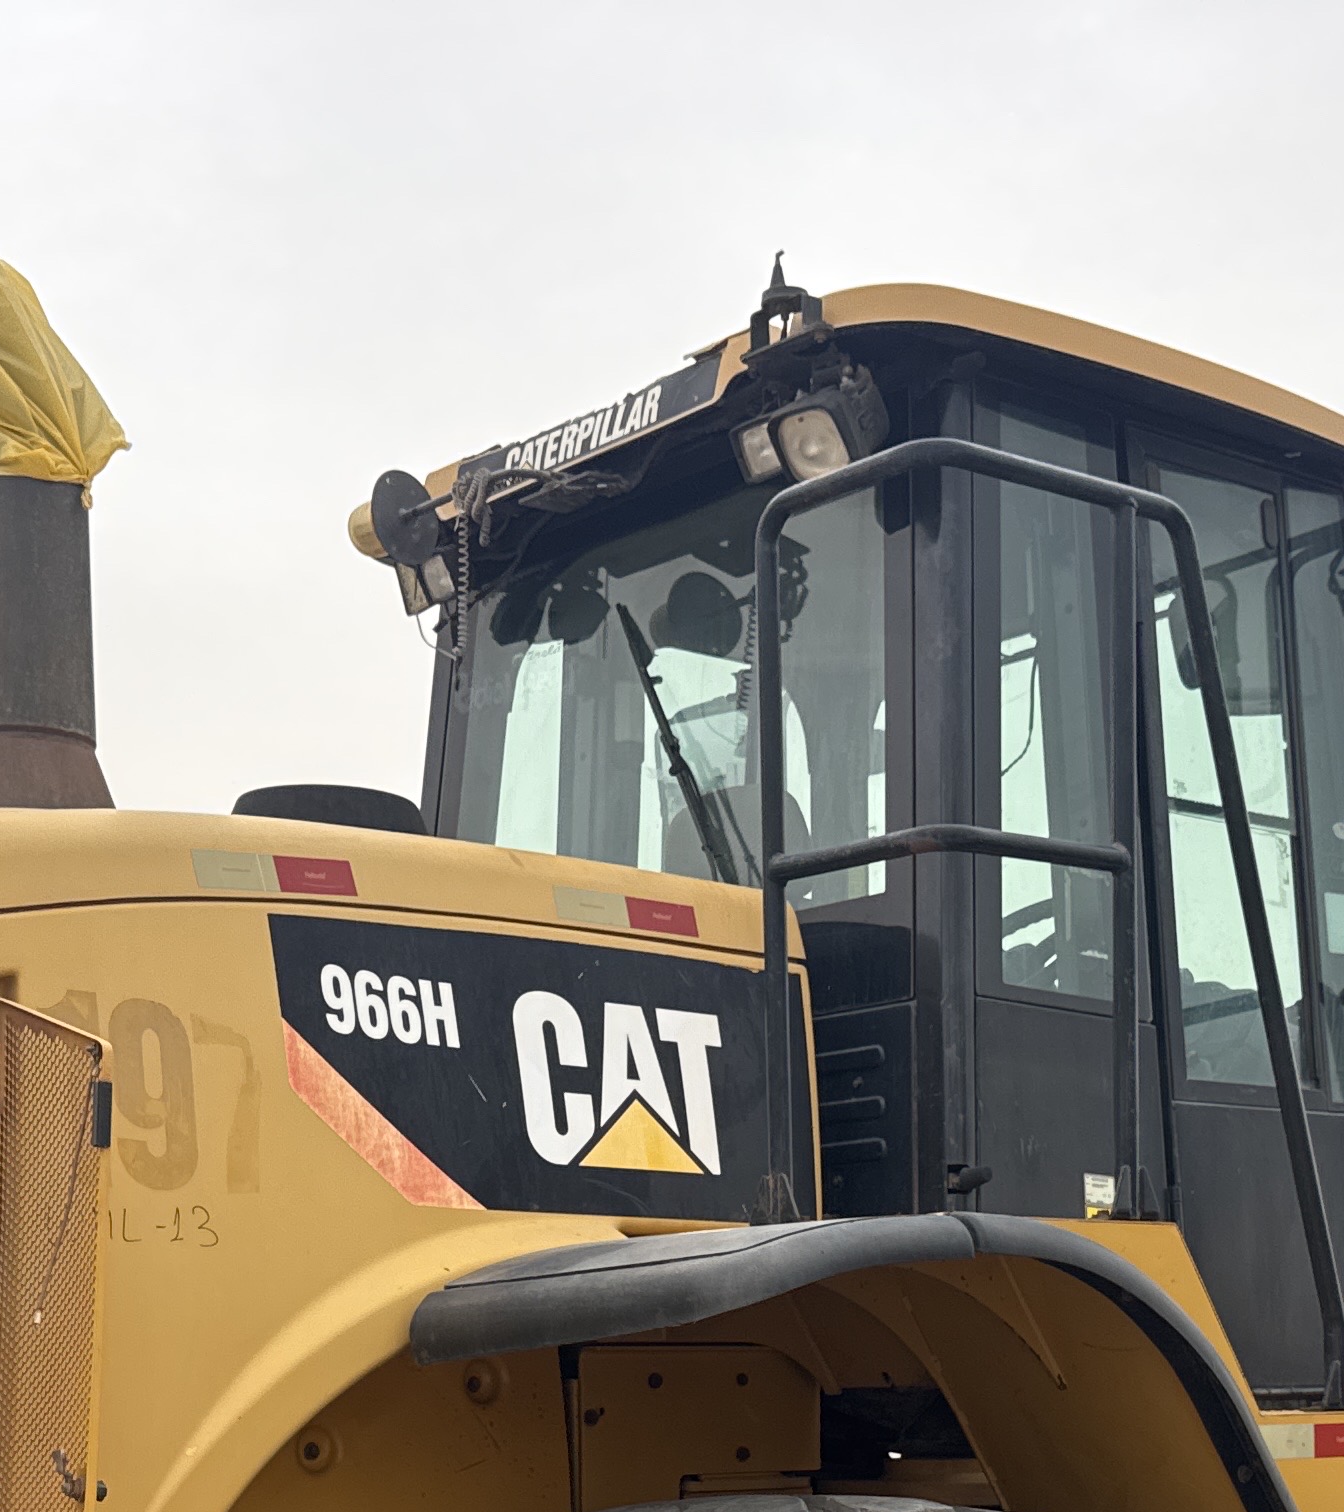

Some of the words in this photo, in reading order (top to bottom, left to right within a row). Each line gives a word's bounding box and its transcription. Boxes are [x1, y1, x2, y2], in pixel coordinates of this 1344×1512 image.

[504, 384, 662, 472] CATERPILLAR
[320, 963, 461, 1049] 966H
[512, 990, 723, 1176] CAT
